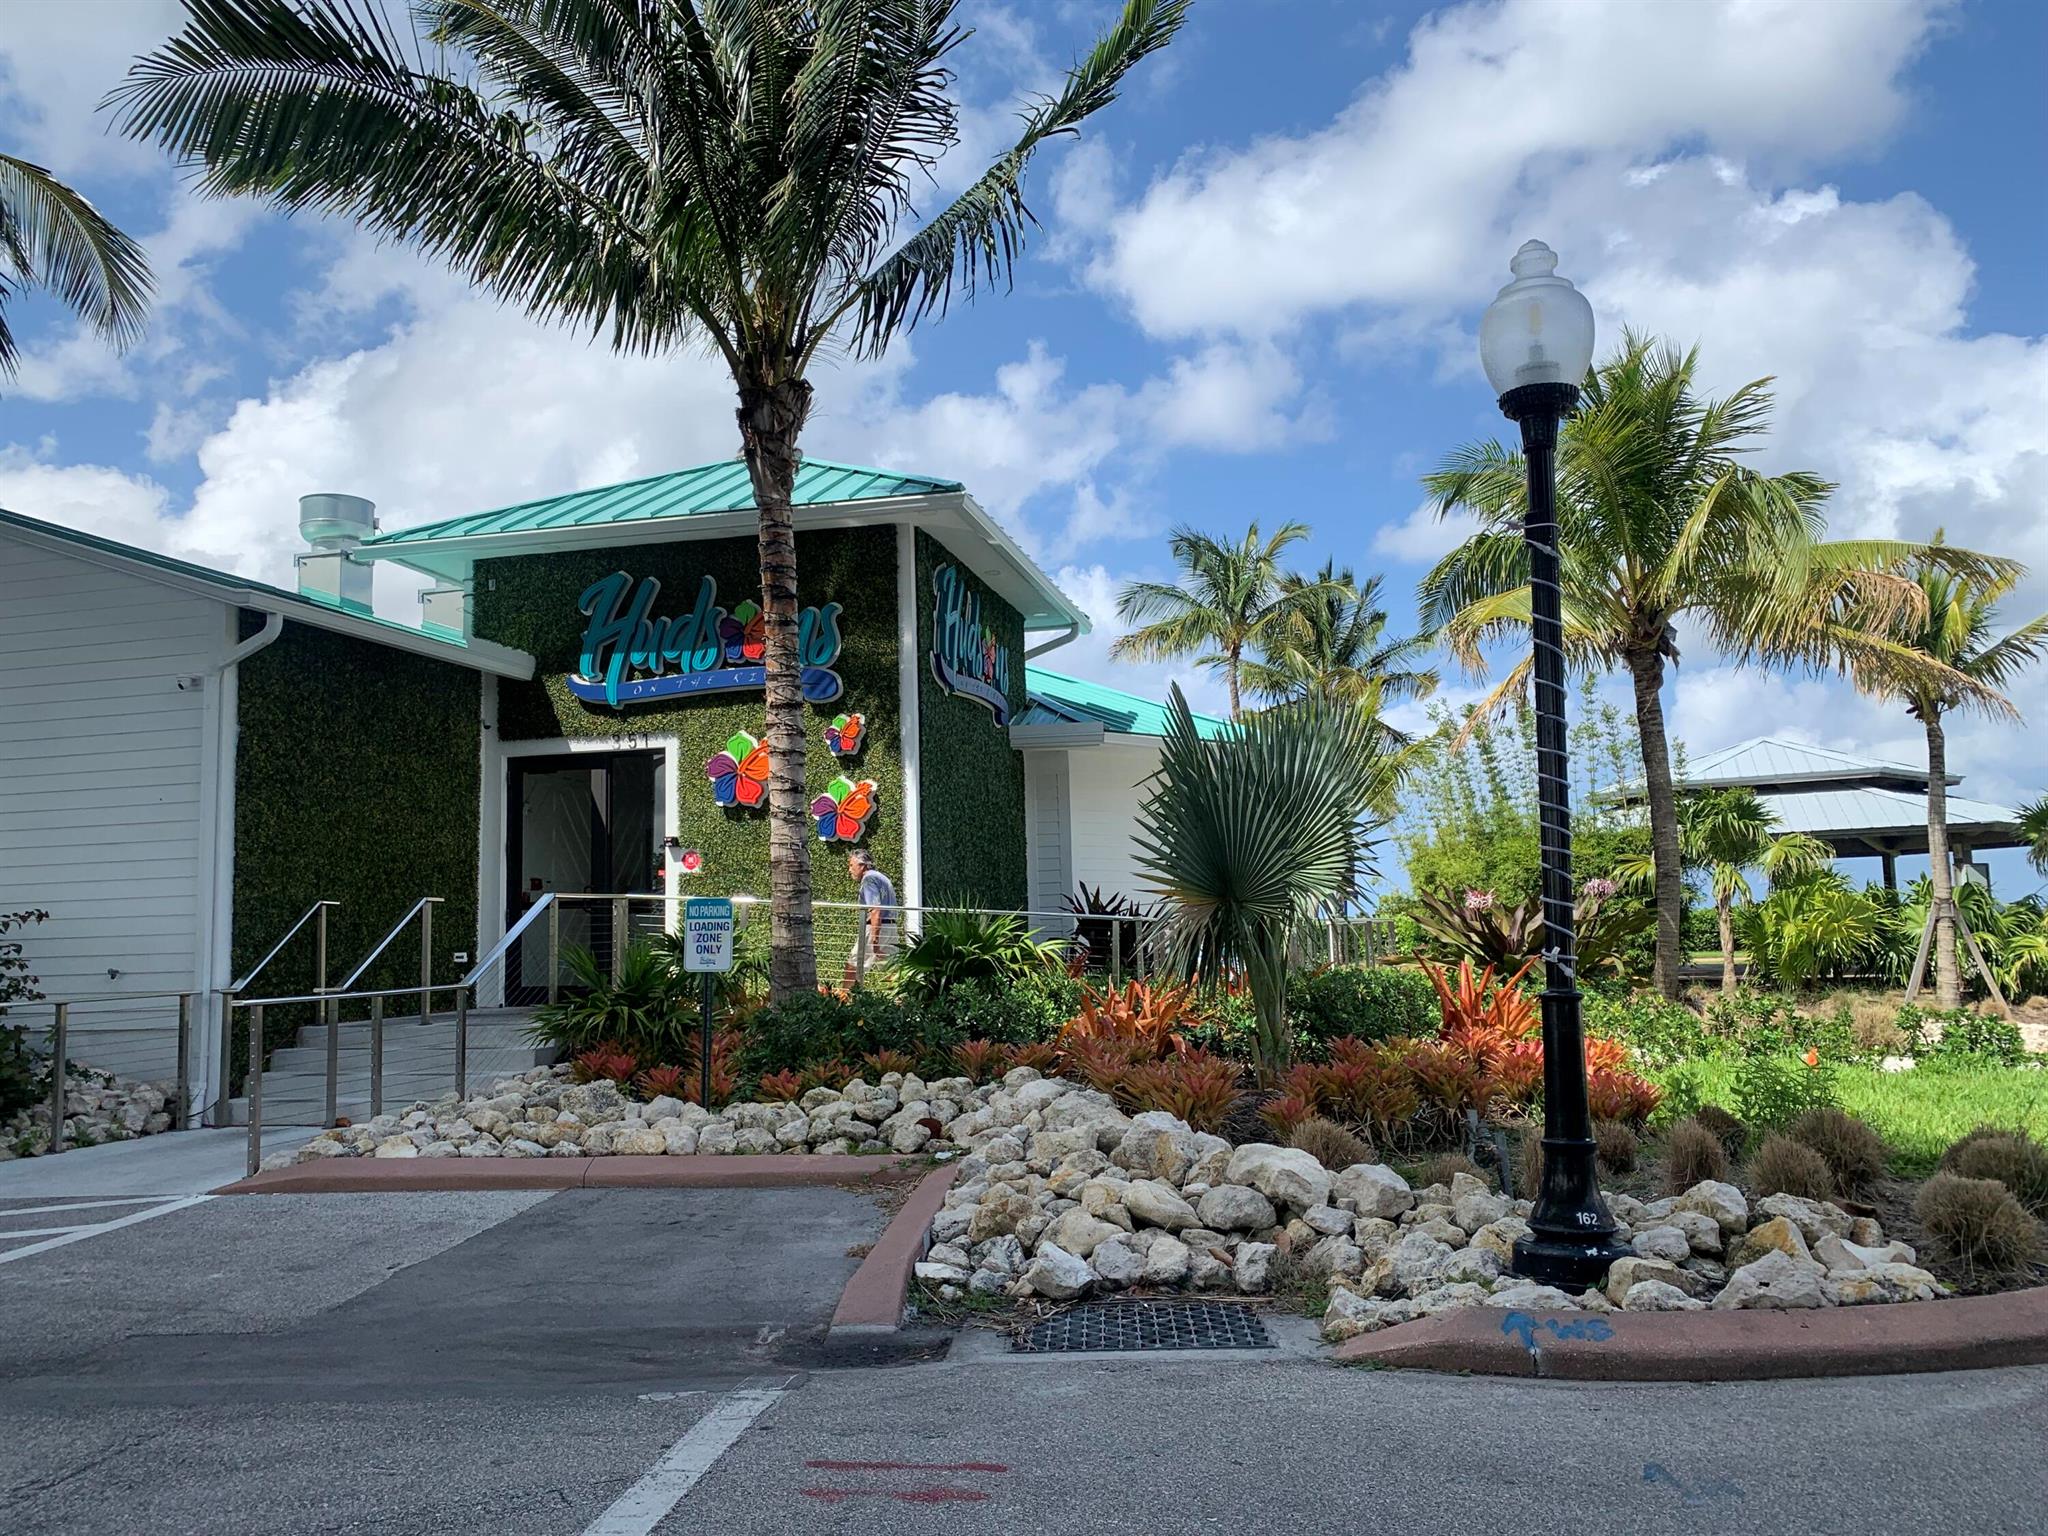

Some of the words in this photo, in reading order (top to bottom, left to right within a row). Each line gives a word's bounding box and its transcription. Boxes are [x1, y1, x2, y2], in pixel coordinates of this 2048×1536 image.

[633, 684, 657, 696] ON
[676, 676, 714, 689] THE
[689, 905, 699, 917] NO
[700, 905, 731, 917] PARKING
[689, 921, 730, 932] LOADING
[696, 933, 723, 943] ZONE
[696, 944, 722, 955] ONLY
[1576, 1211, 1600, 1225] 162
